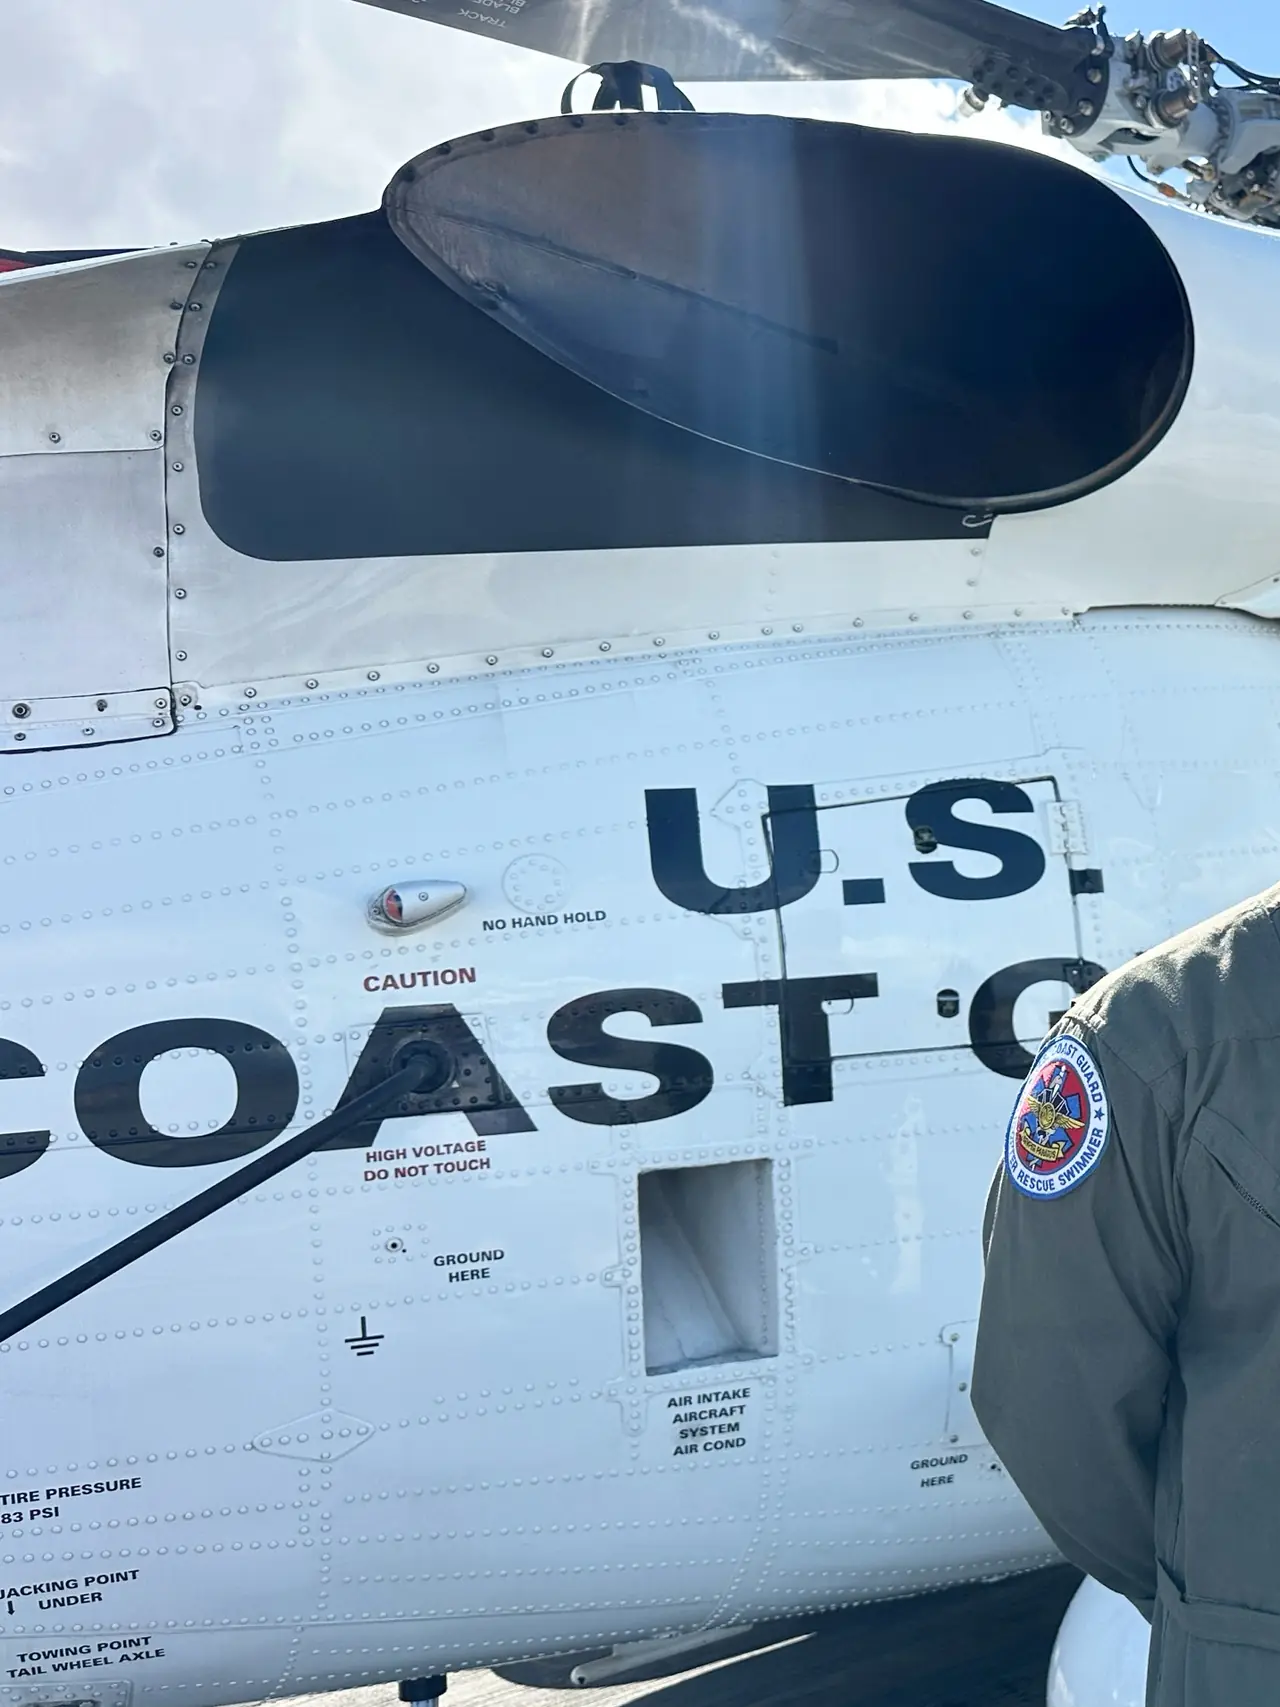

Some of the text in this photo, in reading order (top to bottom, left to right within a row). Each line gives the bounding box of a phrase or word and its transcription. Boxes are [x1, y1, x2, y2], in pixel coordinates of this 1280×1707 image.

[457, 8, 507, 28] TRACK
[644, 777, 1104, 915] U.S.
[482, 910, 607, 931] NO HAND HOLD
[363, 967, 477, 992] CAUTION
[0, 973, 879, 1179] OAST
[1054, 1042, 1104, 1103] OAST GUARD
[366, 1140, 487, 1163] HIGH VOLTAGE
[1017, 1168, 1056, 1192] RESCUE
[1058, 1128, 1104, 1186] SWIMMER
[364, 1158, 491, 1182] DO NOT TOUCH
[433, 1249, 505, 1267] GROUND
[449, 1267, 491, 1282] HERE
[667, 1387, 751, 1408] AIR INTAKE
[672, 1404, 747, 1425] AIRCRAFT
[679, 1422, 740, 1439] SYSTEM
[673, 1437, 746, 1456] AIR COND
[910, 1453, 968, 1470] GROUND
[0, 1477, 142, 1506] TIRE PRESSURE
[920, 1474, 955, 1488] HERE
[1, 1506, 60, 1524] 83 PSI
[0, 1569, 140, 1599] JACKING POINT
[38, 1591, 103, 1610] UNDER
[17, 1636, 152, 1663] TOWING POINT
[6, 1648, 166, 1678] TAIL WHEEL AXLE
